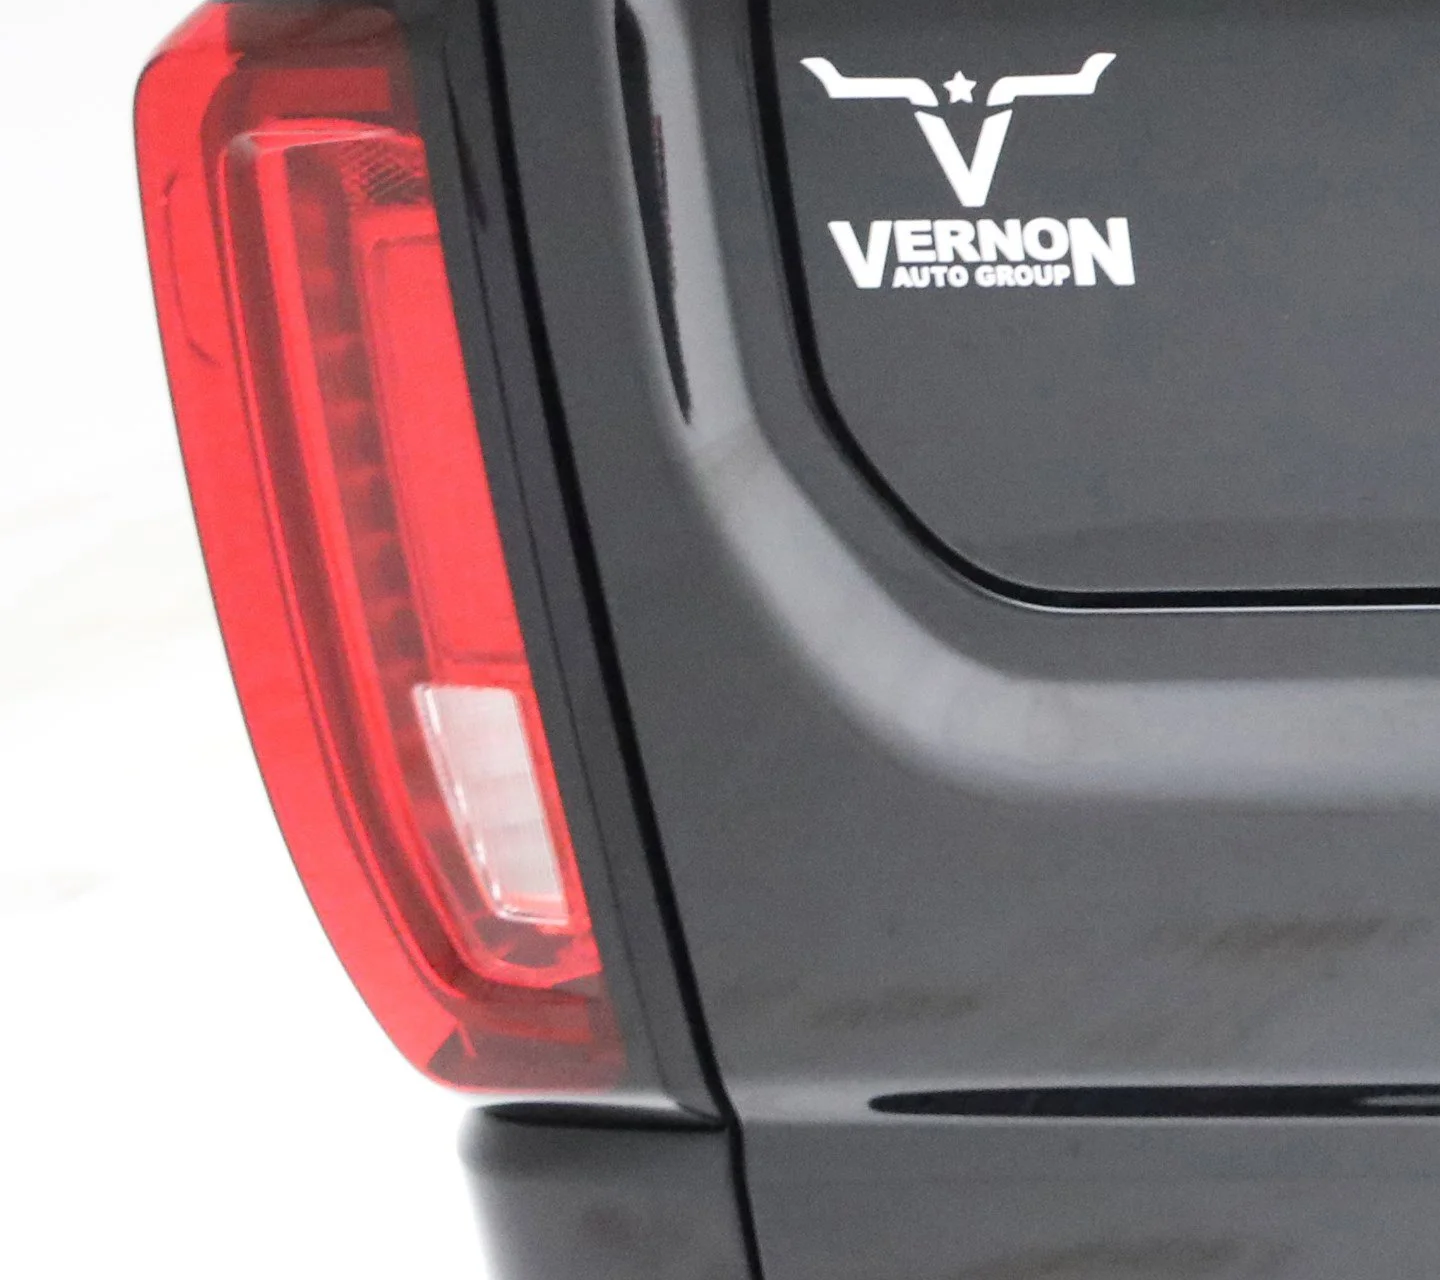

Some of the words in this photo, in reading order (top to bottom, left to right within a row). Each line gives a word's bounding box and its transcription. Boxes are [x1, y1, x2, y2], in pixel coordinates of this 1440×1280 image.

[827, 217, 1136, 289] VERNON
[892, 266, 969, 289] AUTO
[974, 264, 1071, 289] GROUP
